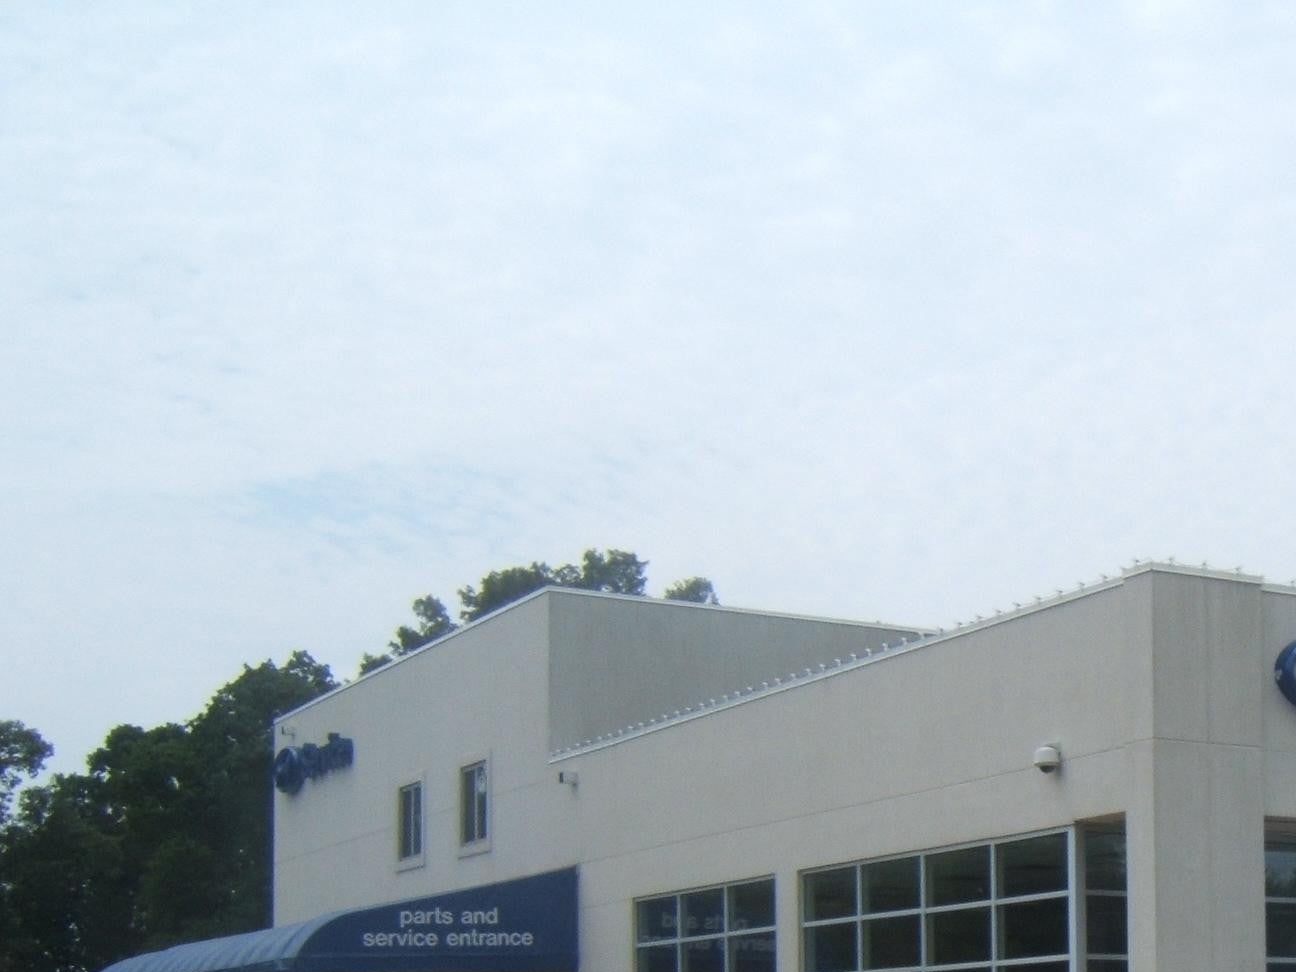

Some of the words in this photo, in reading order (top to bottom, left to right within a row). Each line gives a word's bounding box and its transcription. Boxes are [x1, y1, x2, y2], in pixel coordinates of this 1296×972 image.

[400, 907, 453, 927] parts
[461, 907, 498, 924] and
[363, 929, 438, 946] service
[446, 929, 534, 946] entrance
